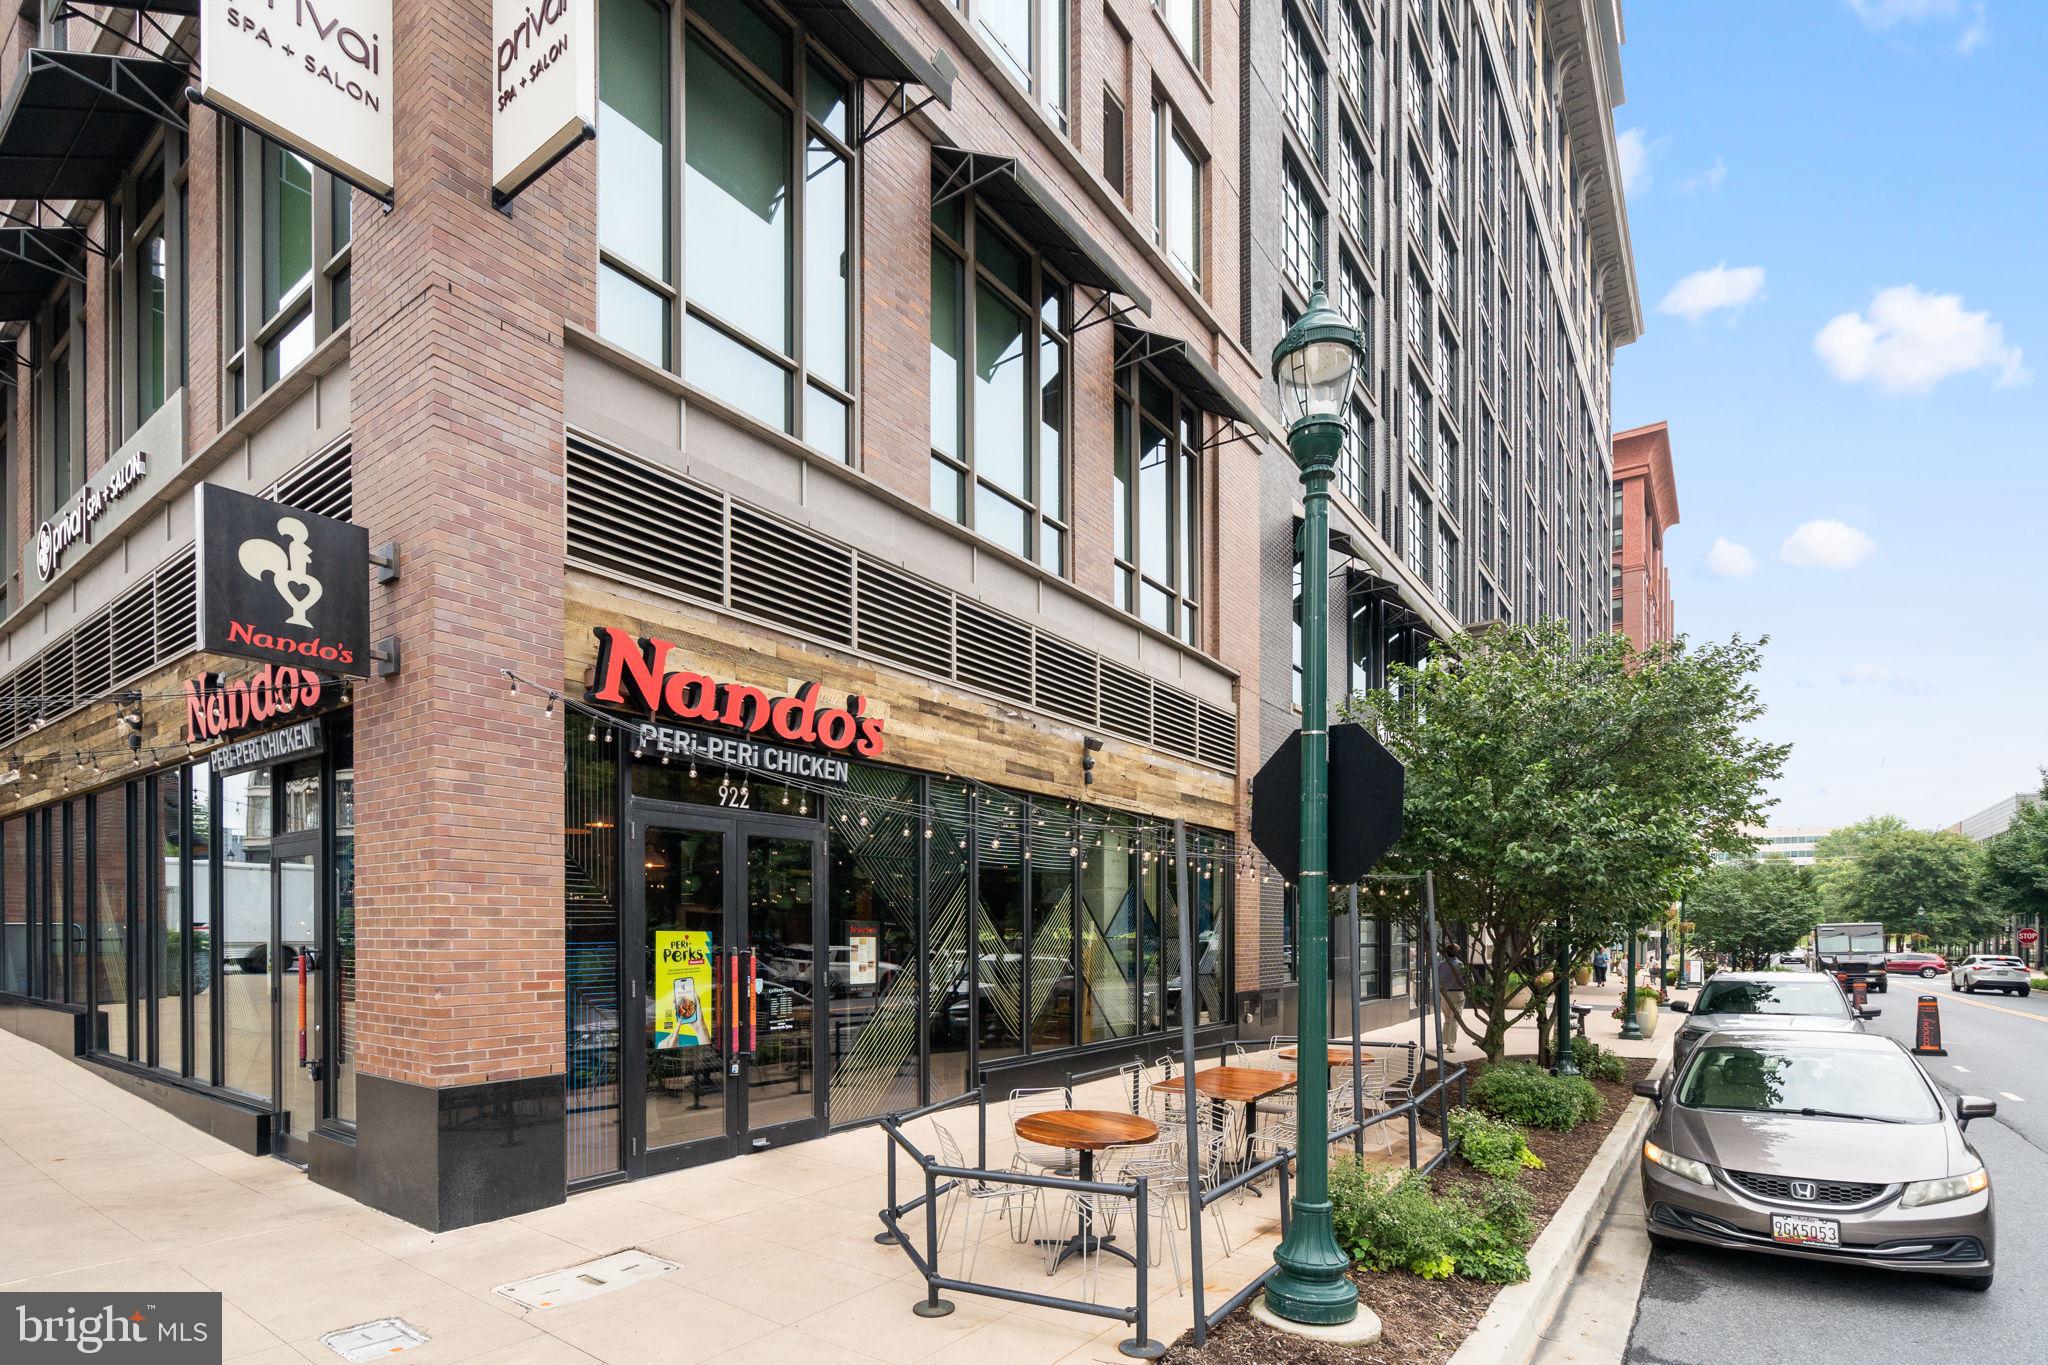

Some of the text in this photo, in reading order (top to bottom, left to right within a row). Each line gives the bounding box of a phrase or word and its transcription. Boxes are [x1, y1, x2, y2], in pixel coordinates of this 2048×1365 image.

[227, 7, 379, 112] SPA + SALON
[498, 84, 518, 112] SPA
[530, 33, 567, 82] SALON
[52, 497, 82, 568] privai
[87, 491, 102, 520] SPA
[110, 451, 142, 498] SALON
[227, 620, 353, 664] Nando's
[594, 626, 885, 758] Nando's
[261, 722, 316, 759] CHICKEN
[763, 748, 849, 783] CHICKEN
[718, 785, 750, 809] 922
[2018, 932, 2037, 940] STOP
[663, 947, 703, 963] Perks
[1775, 1221, 1837, 1241] 9GK5053
